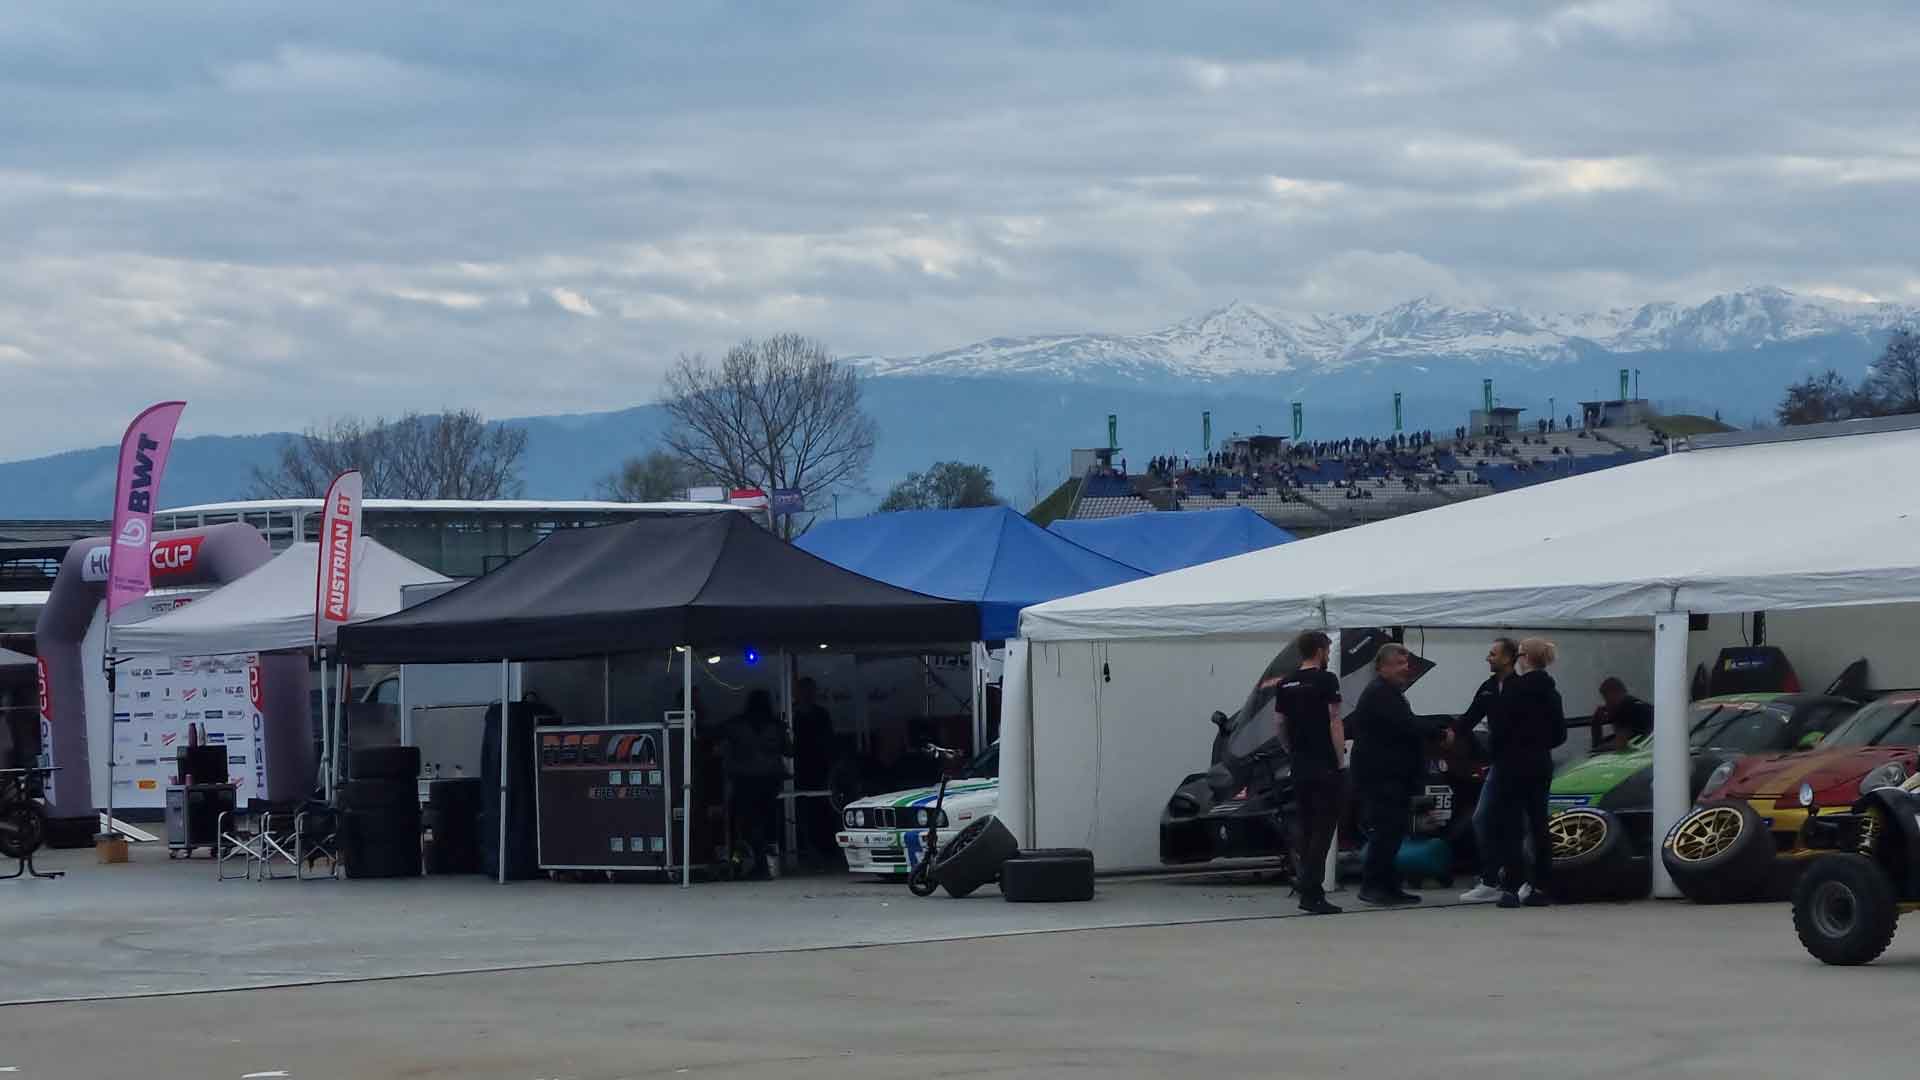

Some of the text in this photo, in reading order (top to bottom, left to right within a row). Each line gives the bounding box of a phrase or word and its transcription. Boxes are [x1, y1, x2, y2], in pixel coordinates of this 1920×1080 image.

[128, 433, 160, 514] BWT
[151, 544, 193, 569] CUP
[328, 492, 351, 618] AUSTRIAN GT
